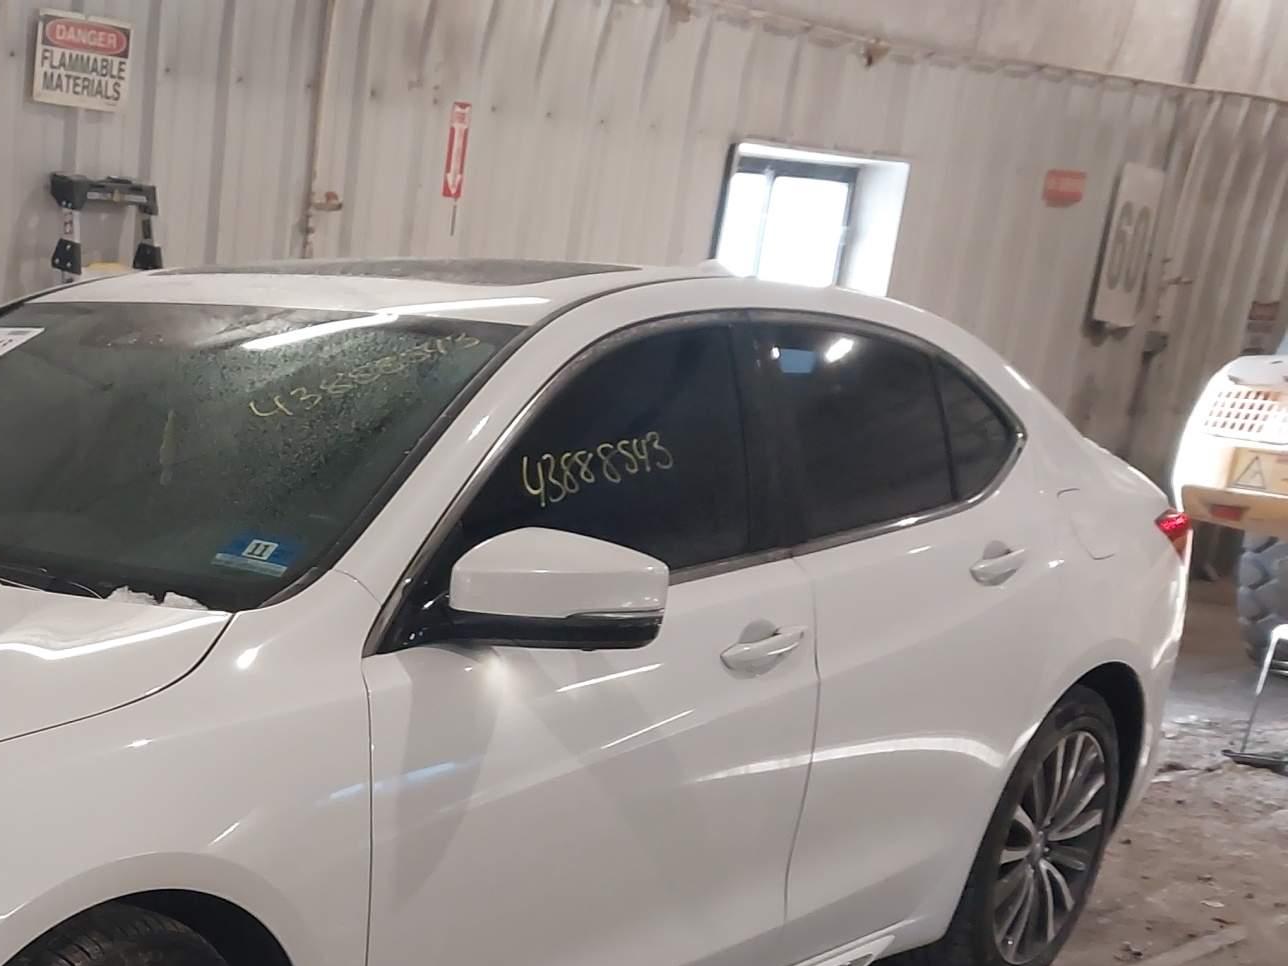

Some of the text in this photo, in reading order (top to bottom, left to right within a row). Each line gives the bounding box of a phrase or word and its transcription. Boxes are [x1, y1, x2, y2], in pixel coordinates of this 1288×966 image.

[55, 23, 117, 49] DANGER
[40, 48, 127, 81] FLAMMABLE
[42, 71, 121, 101] MATERIALS
[522, 431, 674, 508] 43888543
